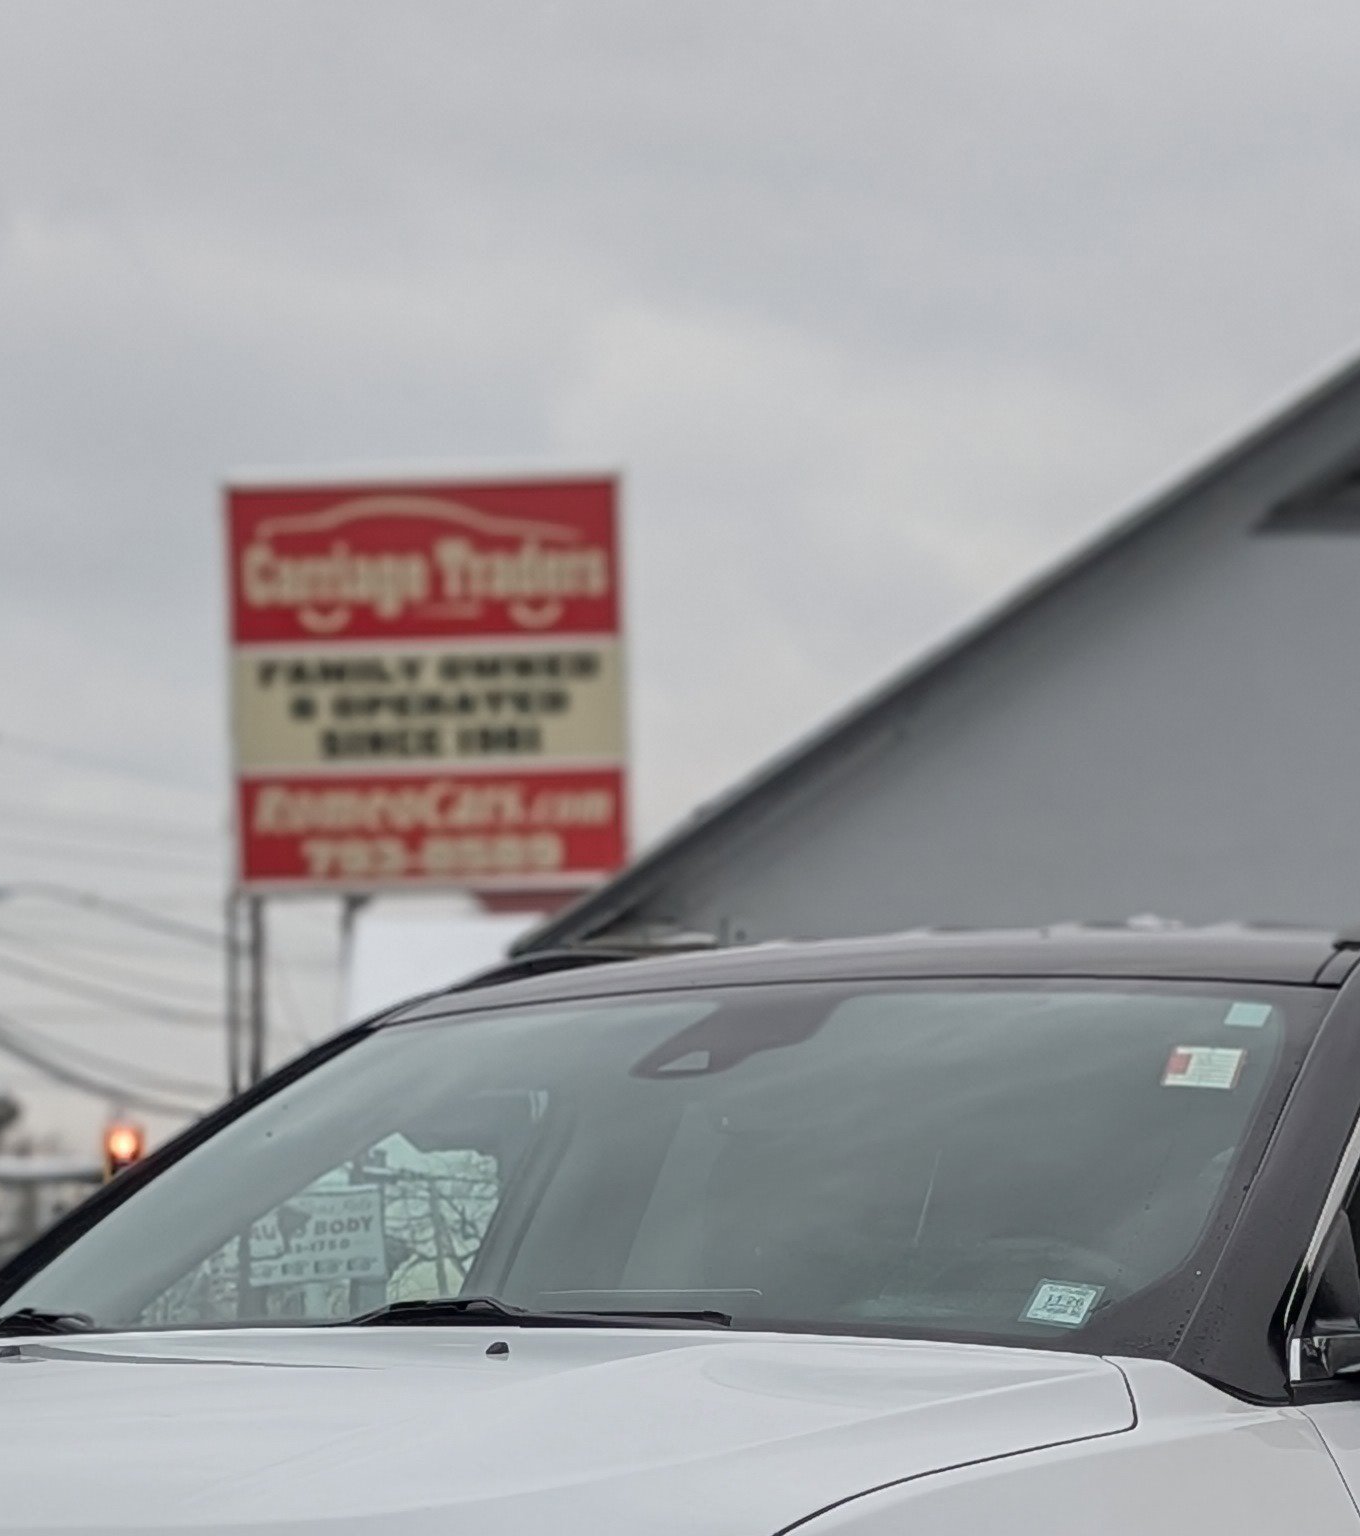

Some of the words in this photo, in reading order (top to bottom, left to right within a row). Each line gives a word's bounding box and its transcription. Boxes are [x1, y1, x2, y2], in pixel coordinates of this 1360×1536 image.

[436, 537, 607, 600] Traders
[256, 655, 426, 689] FAMILY
[438, 650, 601, 681] OWNED
[331, 687, 571, 721] OPERATED
[319, 726, 443, 761] SINCE
[314, 1215, 374, 1236] BODY
